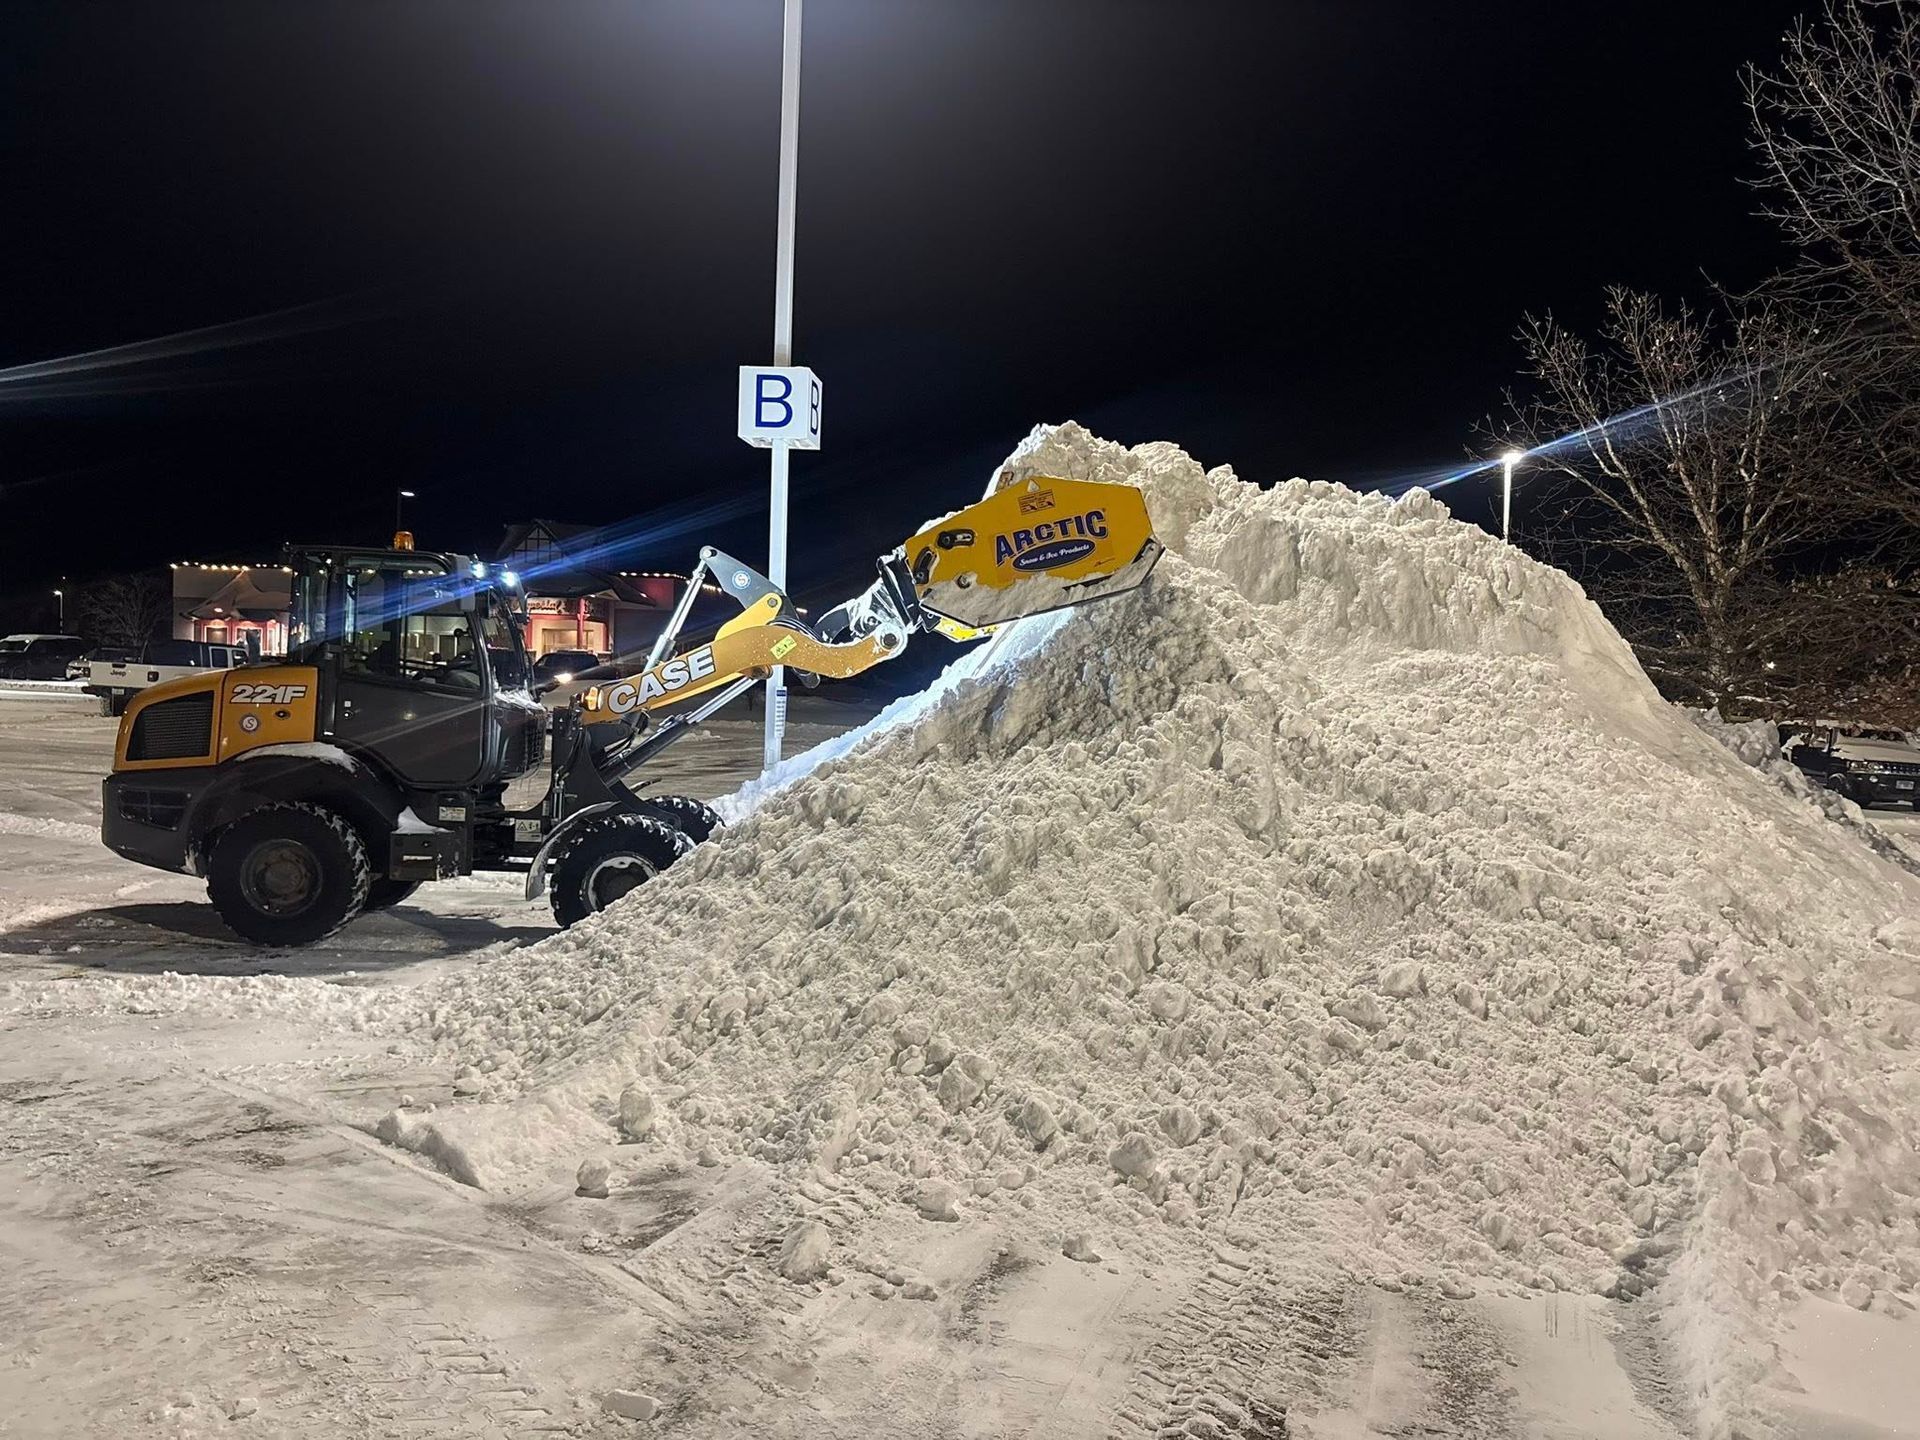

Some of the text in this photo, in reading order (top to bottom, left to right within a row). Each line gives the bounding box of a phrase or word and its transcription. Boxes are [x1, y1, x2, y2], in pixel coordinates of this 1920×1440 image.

[755, 374, 793, 428] B
[810, 380, 819, 436] B
[996, 509, 1108, 566] ARCTIC
[1019, 558, 1038, 567] Snow
[1046, 552, 1059, 560] Ice
[1059, 544, 1090, 556] Products
[110, 670, 127, 678] Jeep
[230, 684, 308, 704] 221F
[608, 646, 716, 714] CASE
